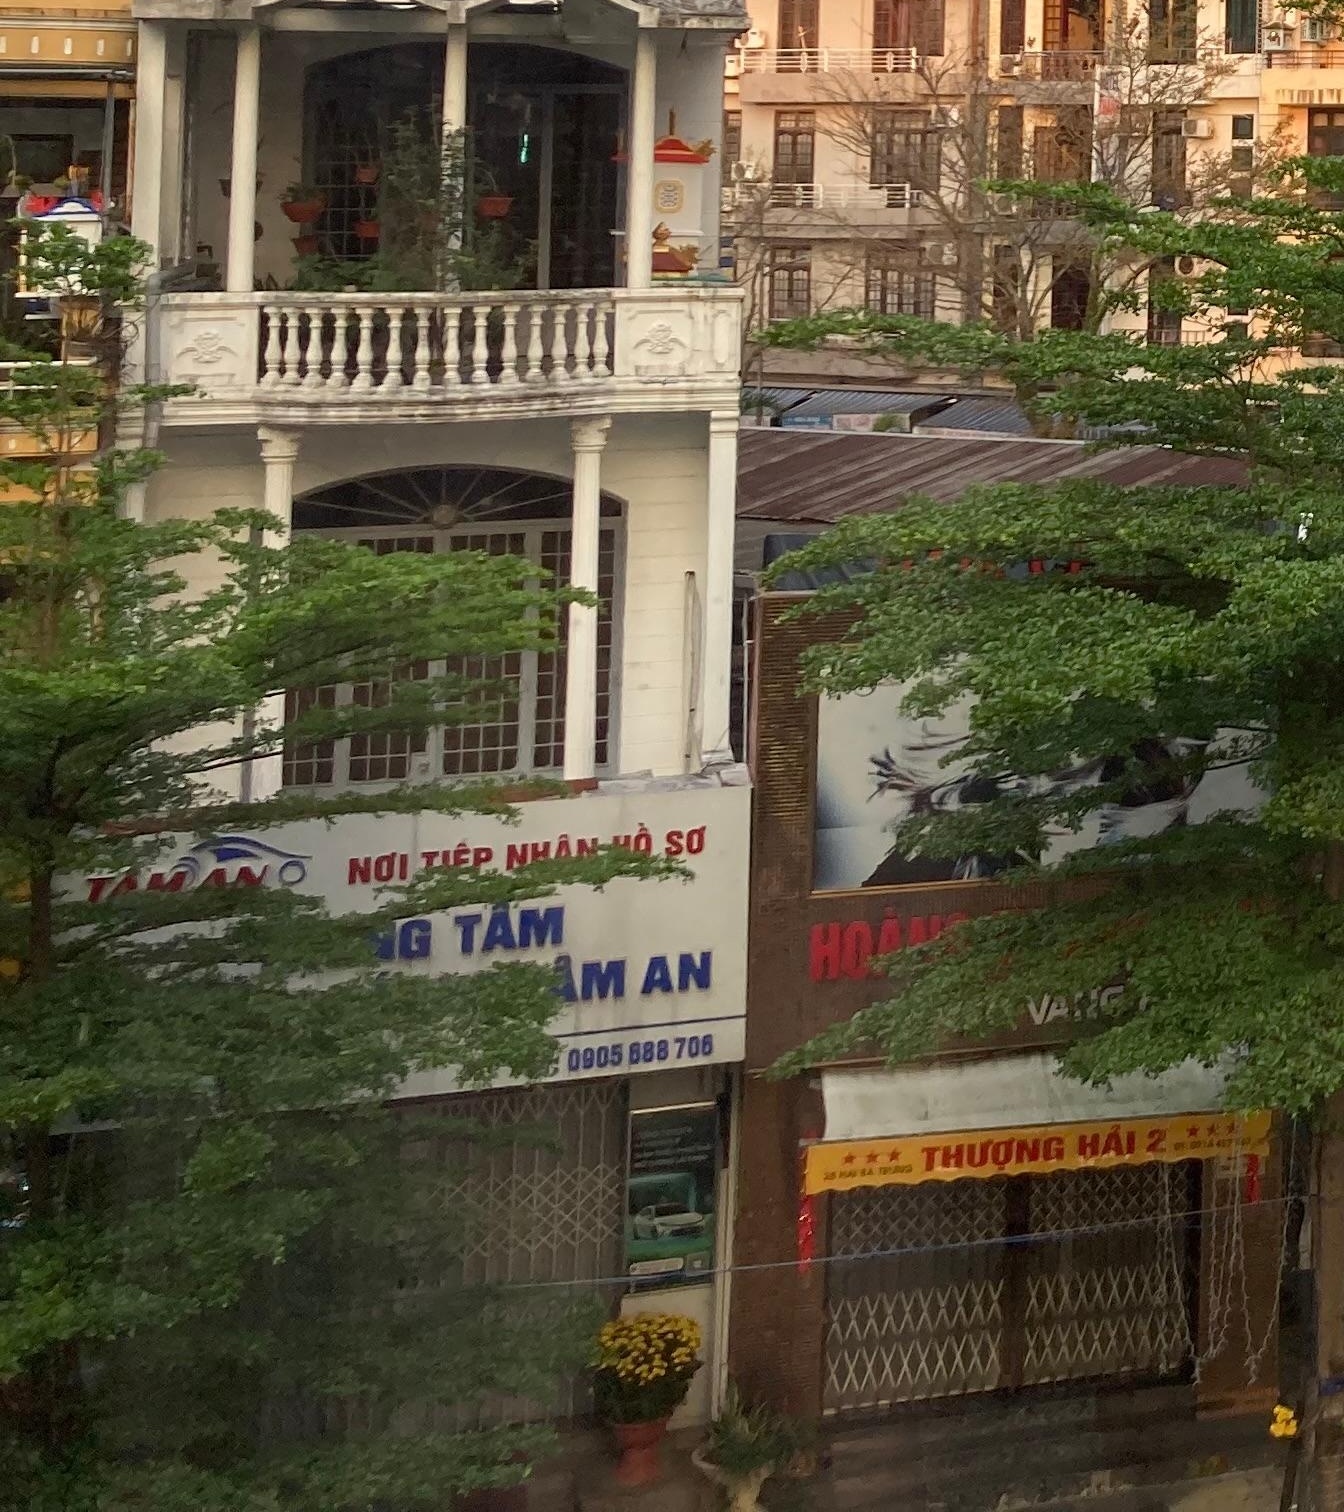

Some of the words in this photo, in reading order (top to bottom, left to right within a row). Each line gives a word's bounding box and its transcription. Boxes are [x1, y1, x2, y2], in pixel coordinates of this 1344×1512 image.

[348, 852, 409, 885] NƠI
[665, 826, 706, 856] SƠ
[640, 951, 712, 994] AN
[568, 1044, 624, 1072] 0905
[921, 1129, 1065, 1173] THƯỢNG
[1078, 1124, 1136, 1157] HẢI
[1146, 1128, 1167, 1153] 2
